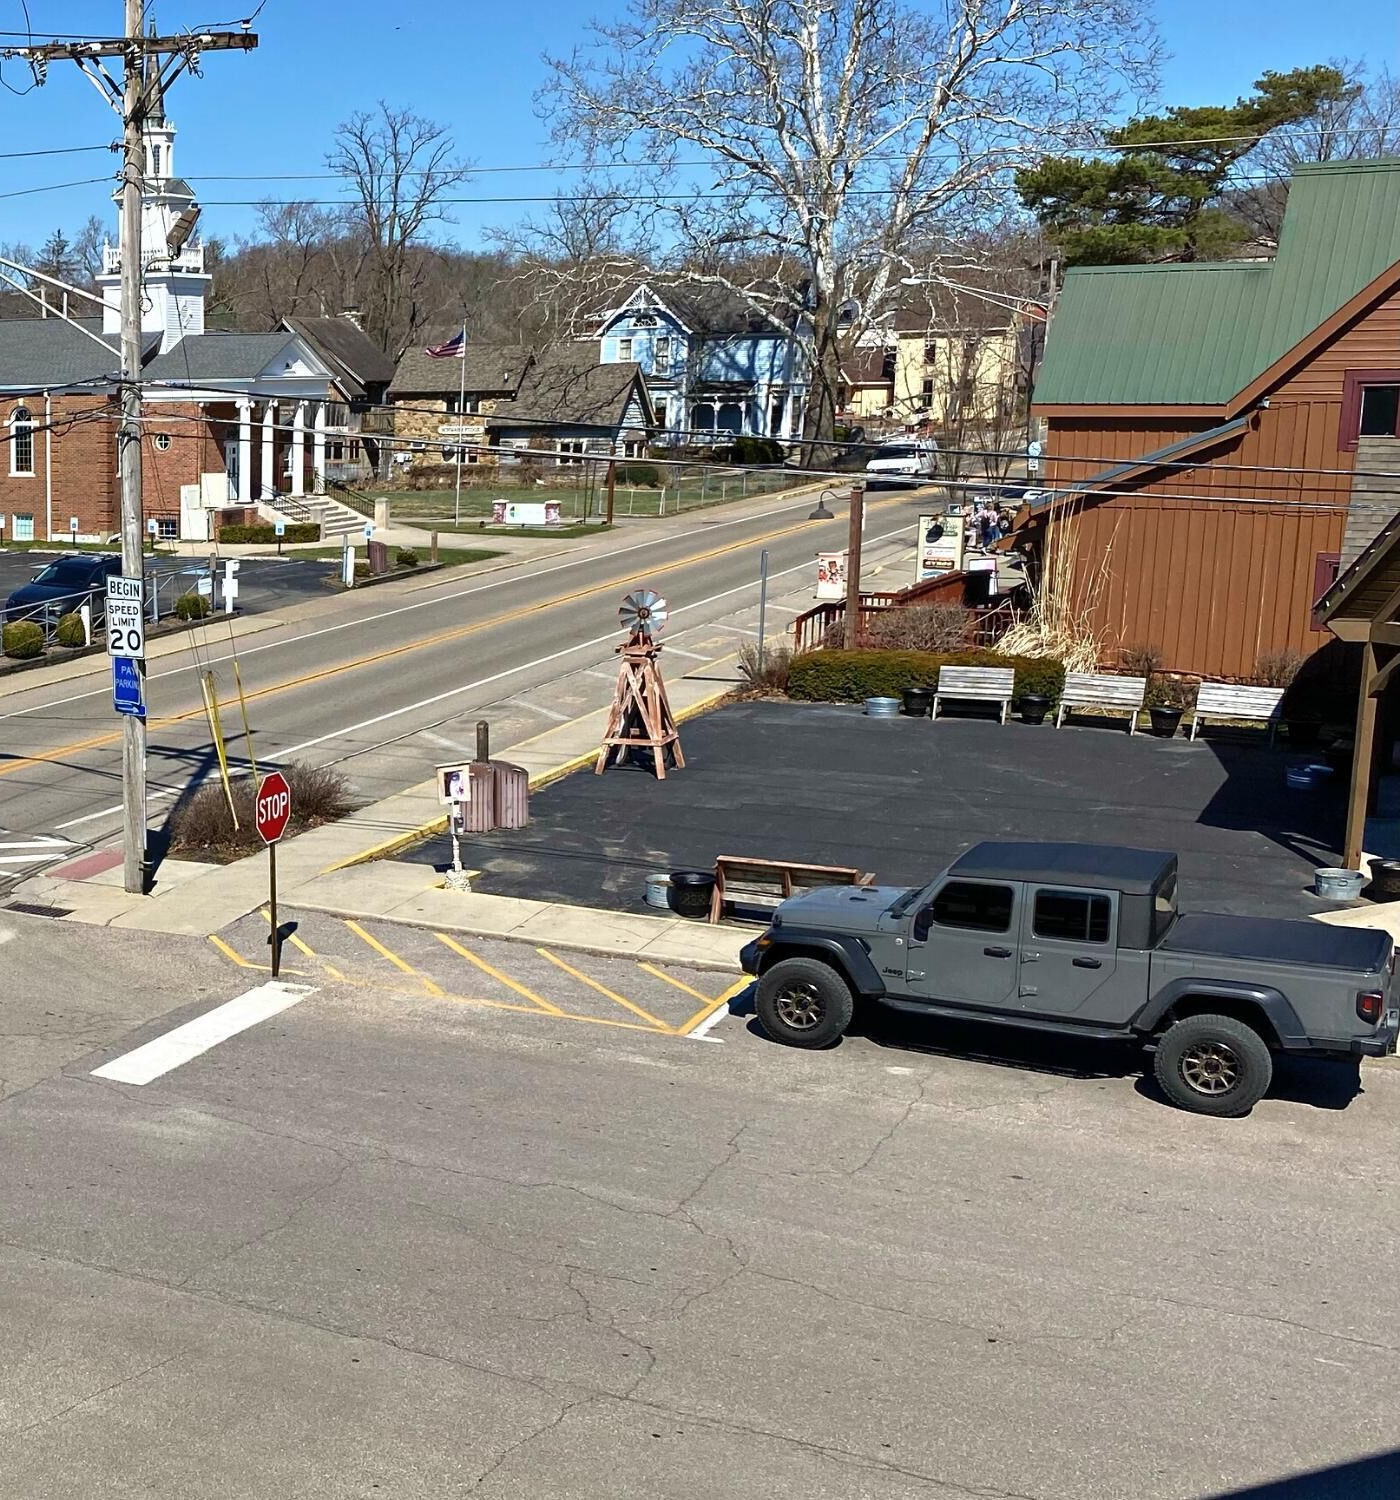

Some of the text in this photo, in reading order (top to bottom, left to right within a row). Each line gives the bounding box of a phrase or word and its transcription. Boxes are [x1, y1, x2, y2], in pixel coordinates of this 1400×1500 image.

[110, 580, 140, 598] BEGIN
[108, 605, 139, 615] SPEED
[112, 617, 136, 627] LIMIT
[110, 628, 141, 651] 20
[121, 665, 135, 676] PAY
[259, 792, 288, 824] STOP
[882, 966, 903, 976] Jeep
